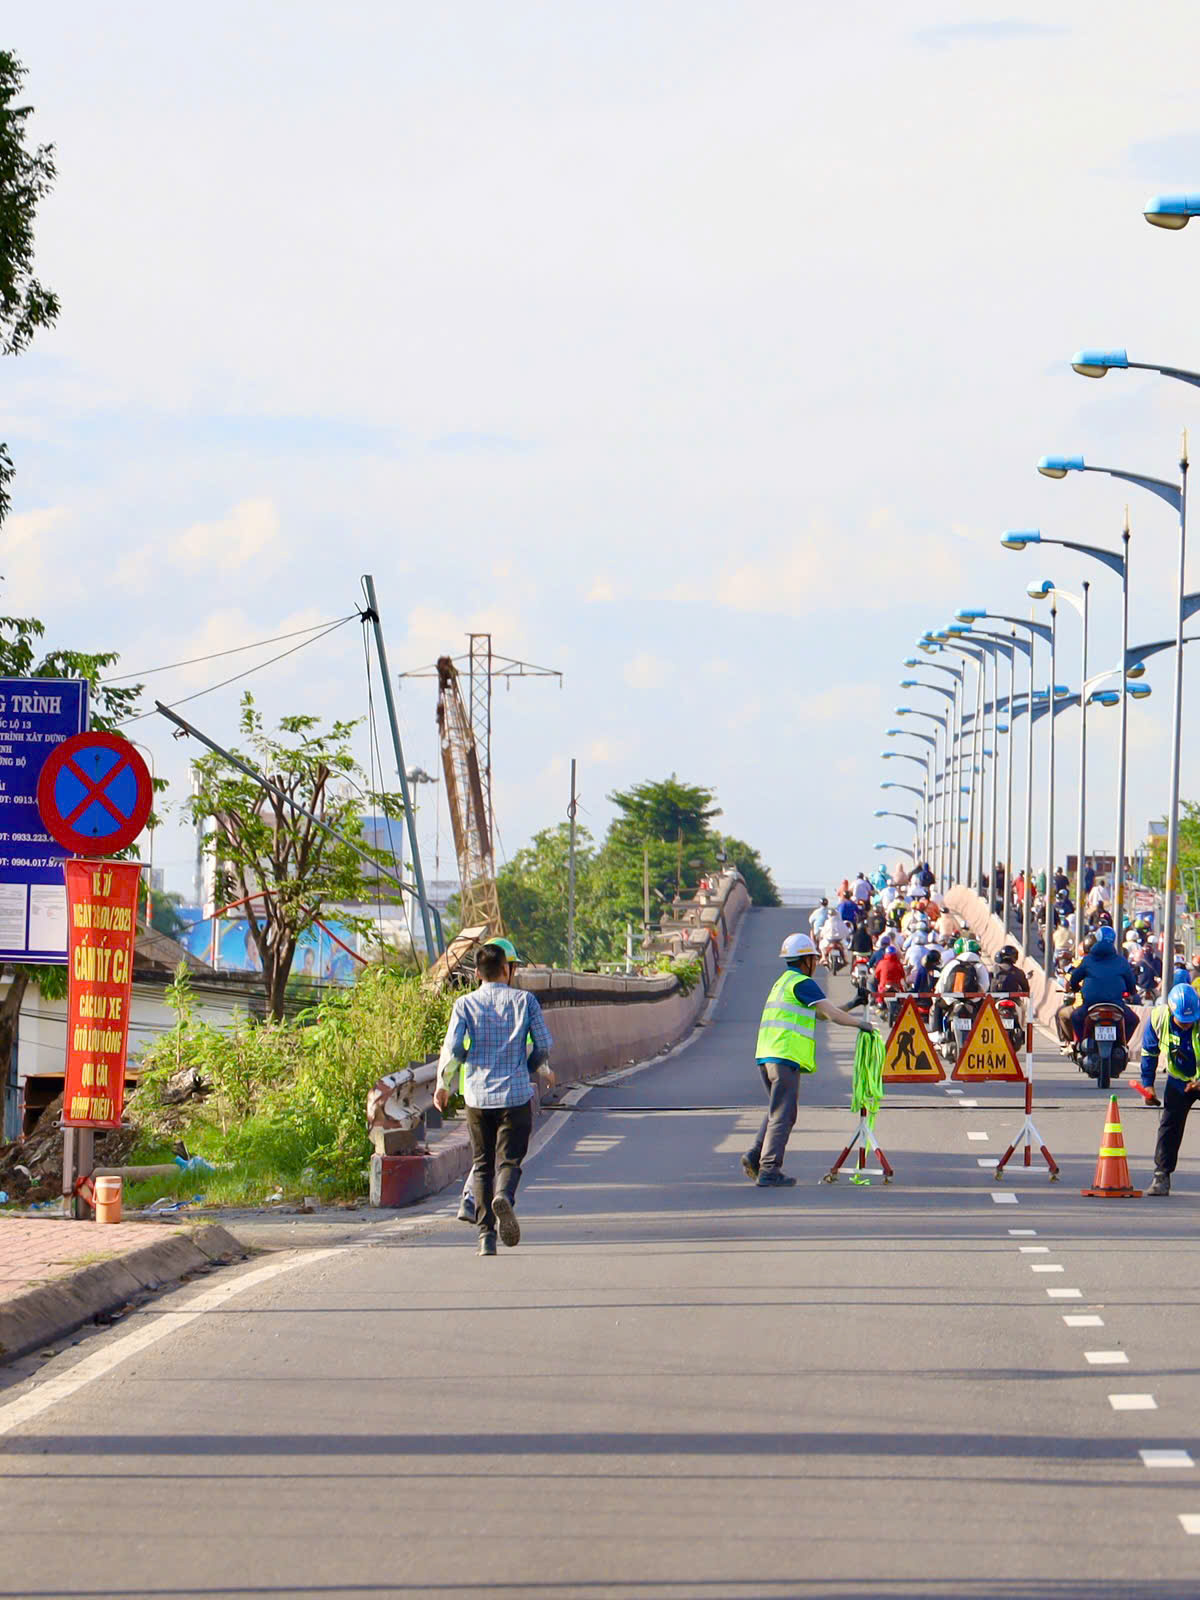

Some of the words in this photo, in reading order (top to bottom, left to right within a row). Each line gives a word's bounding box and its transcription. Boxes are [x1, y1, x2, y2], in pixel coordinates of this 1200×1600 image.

[11, 690, 61, 714] TRÌNH
[9, 718, 19, 730] LỘ
[23, 721, 32, 729] 13
[26, 732, 43, 742] XÂY
[15, 756, 27, 768] BỘ
[75, 934, 96, 982] CẤM
[113, 937, 129, 984] CẢ
[109, 997, 122, 1020] XE
[981, 1028, 994, 1044] ĐI
[968, 1050, 1006, 1073] CHẬM
